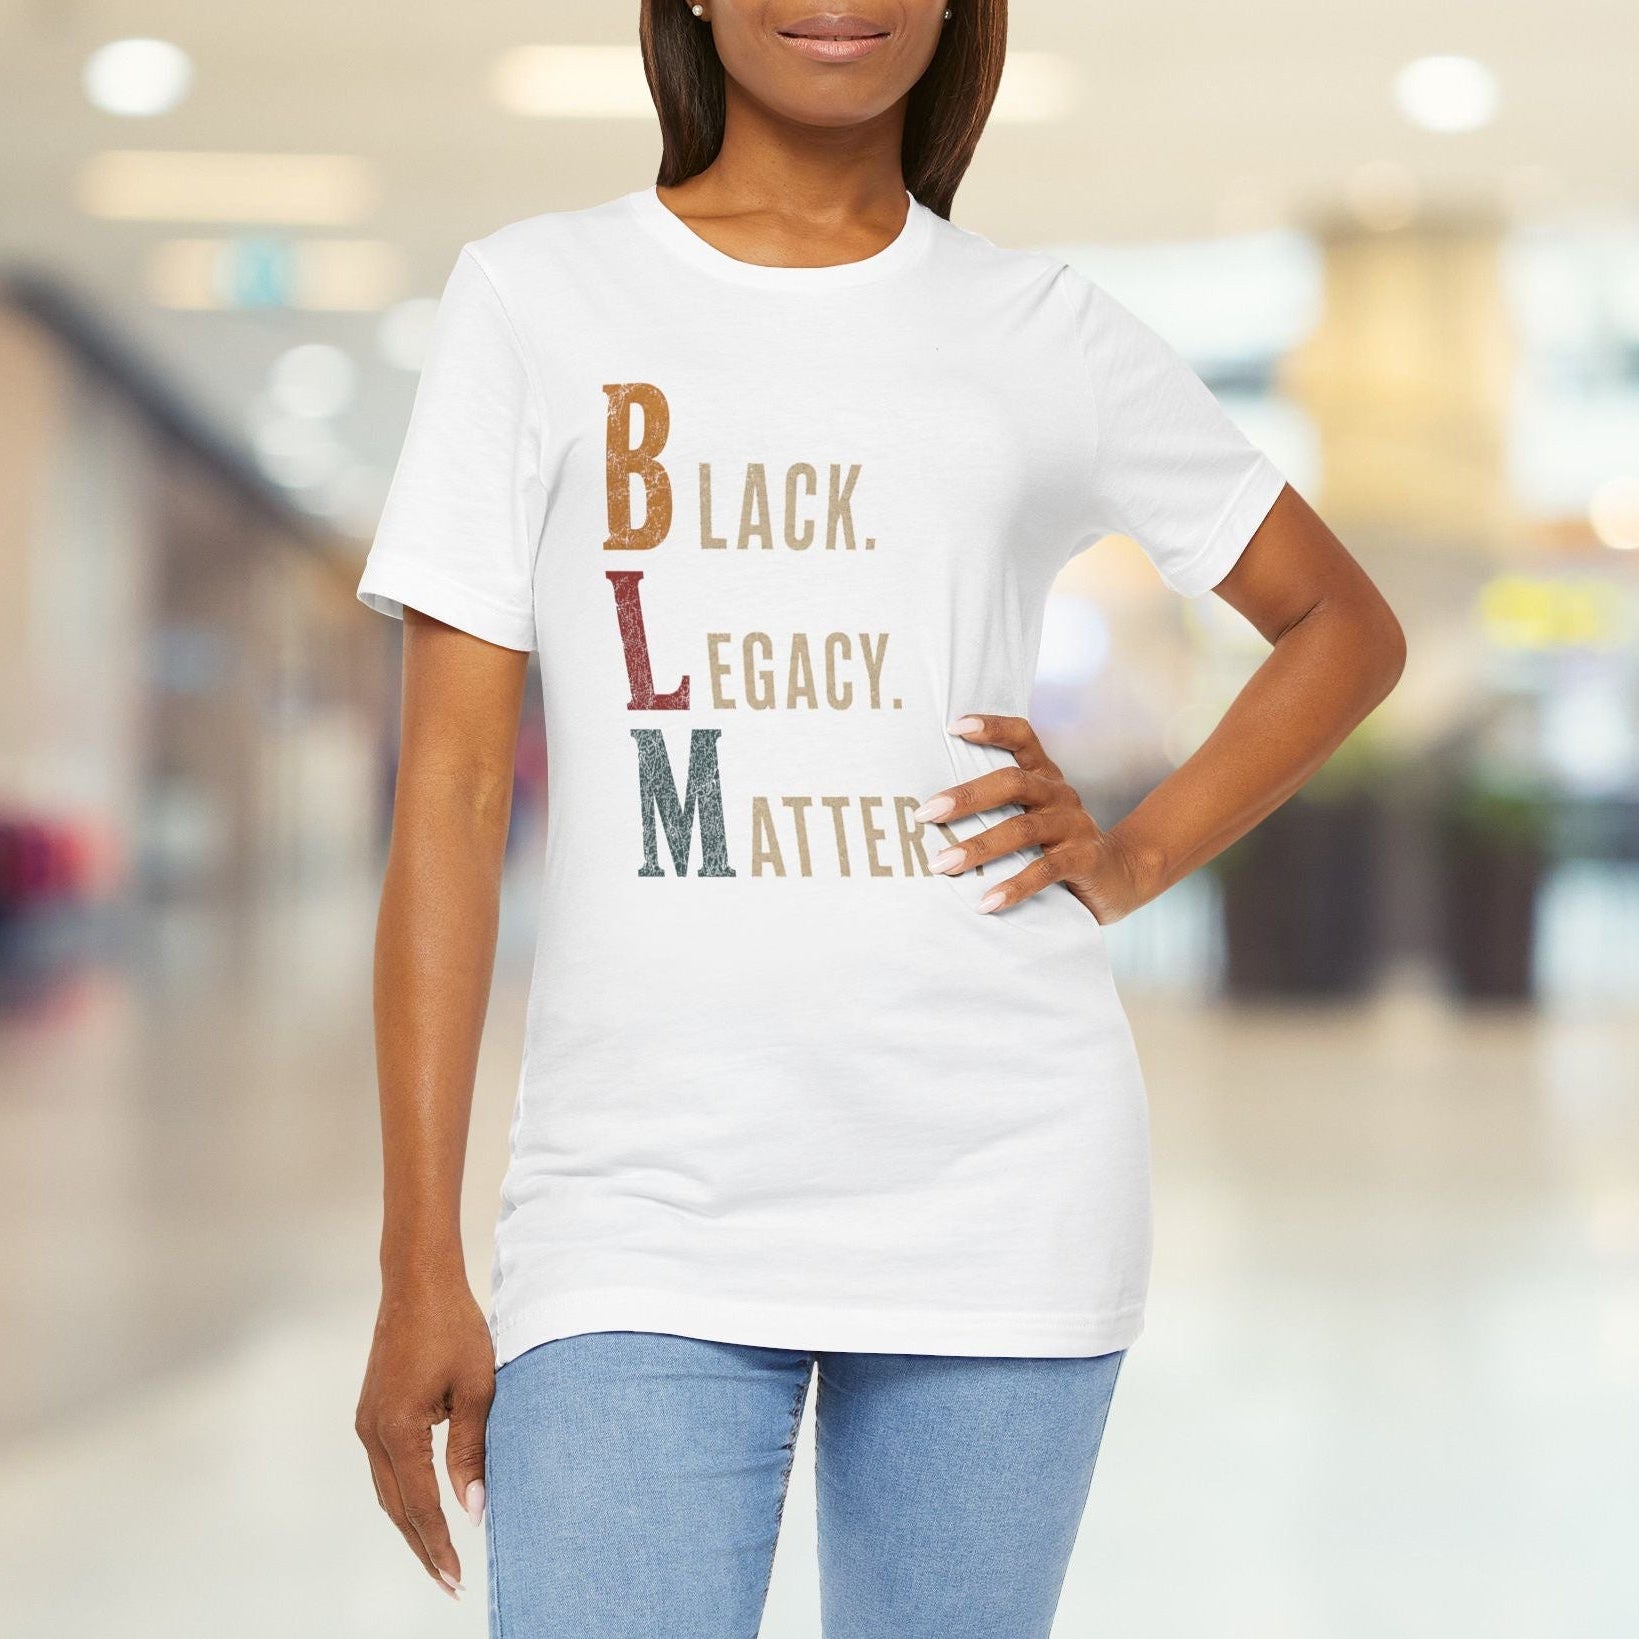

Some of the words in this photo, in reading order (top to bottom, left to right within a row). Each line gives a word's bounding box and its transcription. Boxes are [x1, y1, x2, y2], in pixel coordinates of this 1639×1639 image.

[602, 382, 876, 551] BLACK.
[605, 570, 902, 711] LEGACY.
[630, 728, 984, 878] MATTER.
